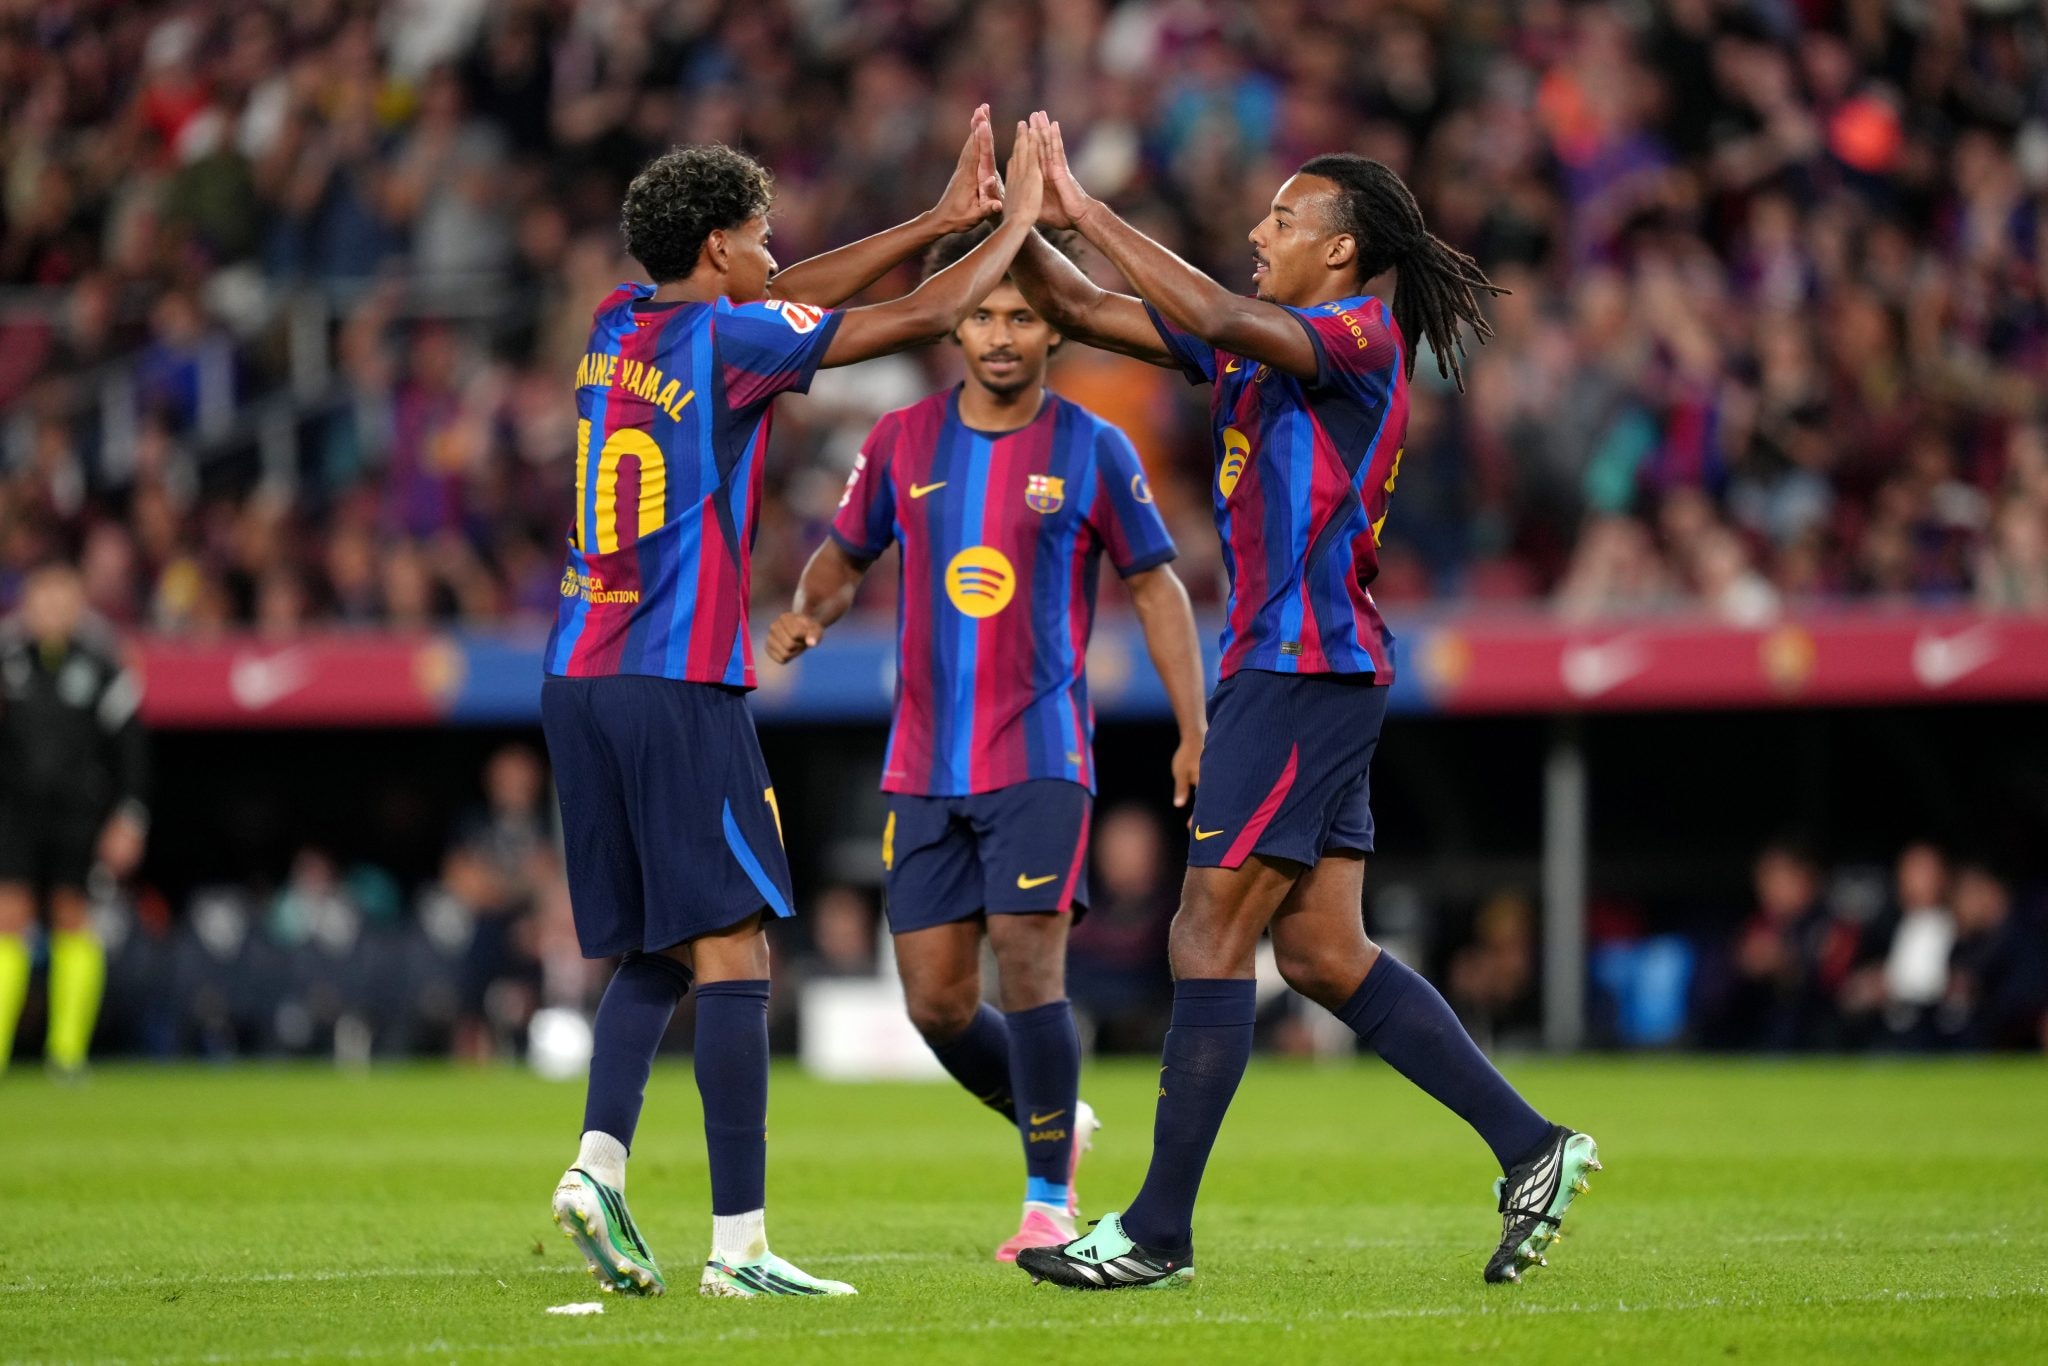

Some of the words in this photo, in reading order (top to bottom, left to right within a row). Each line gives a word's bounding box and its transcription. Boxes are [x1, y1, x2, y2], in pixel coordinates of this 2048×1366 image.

[1323, 301, 1368, 349] Midea
[620, 359, 696, 423] YAMAL
[575, 418, 667, 555] 10
